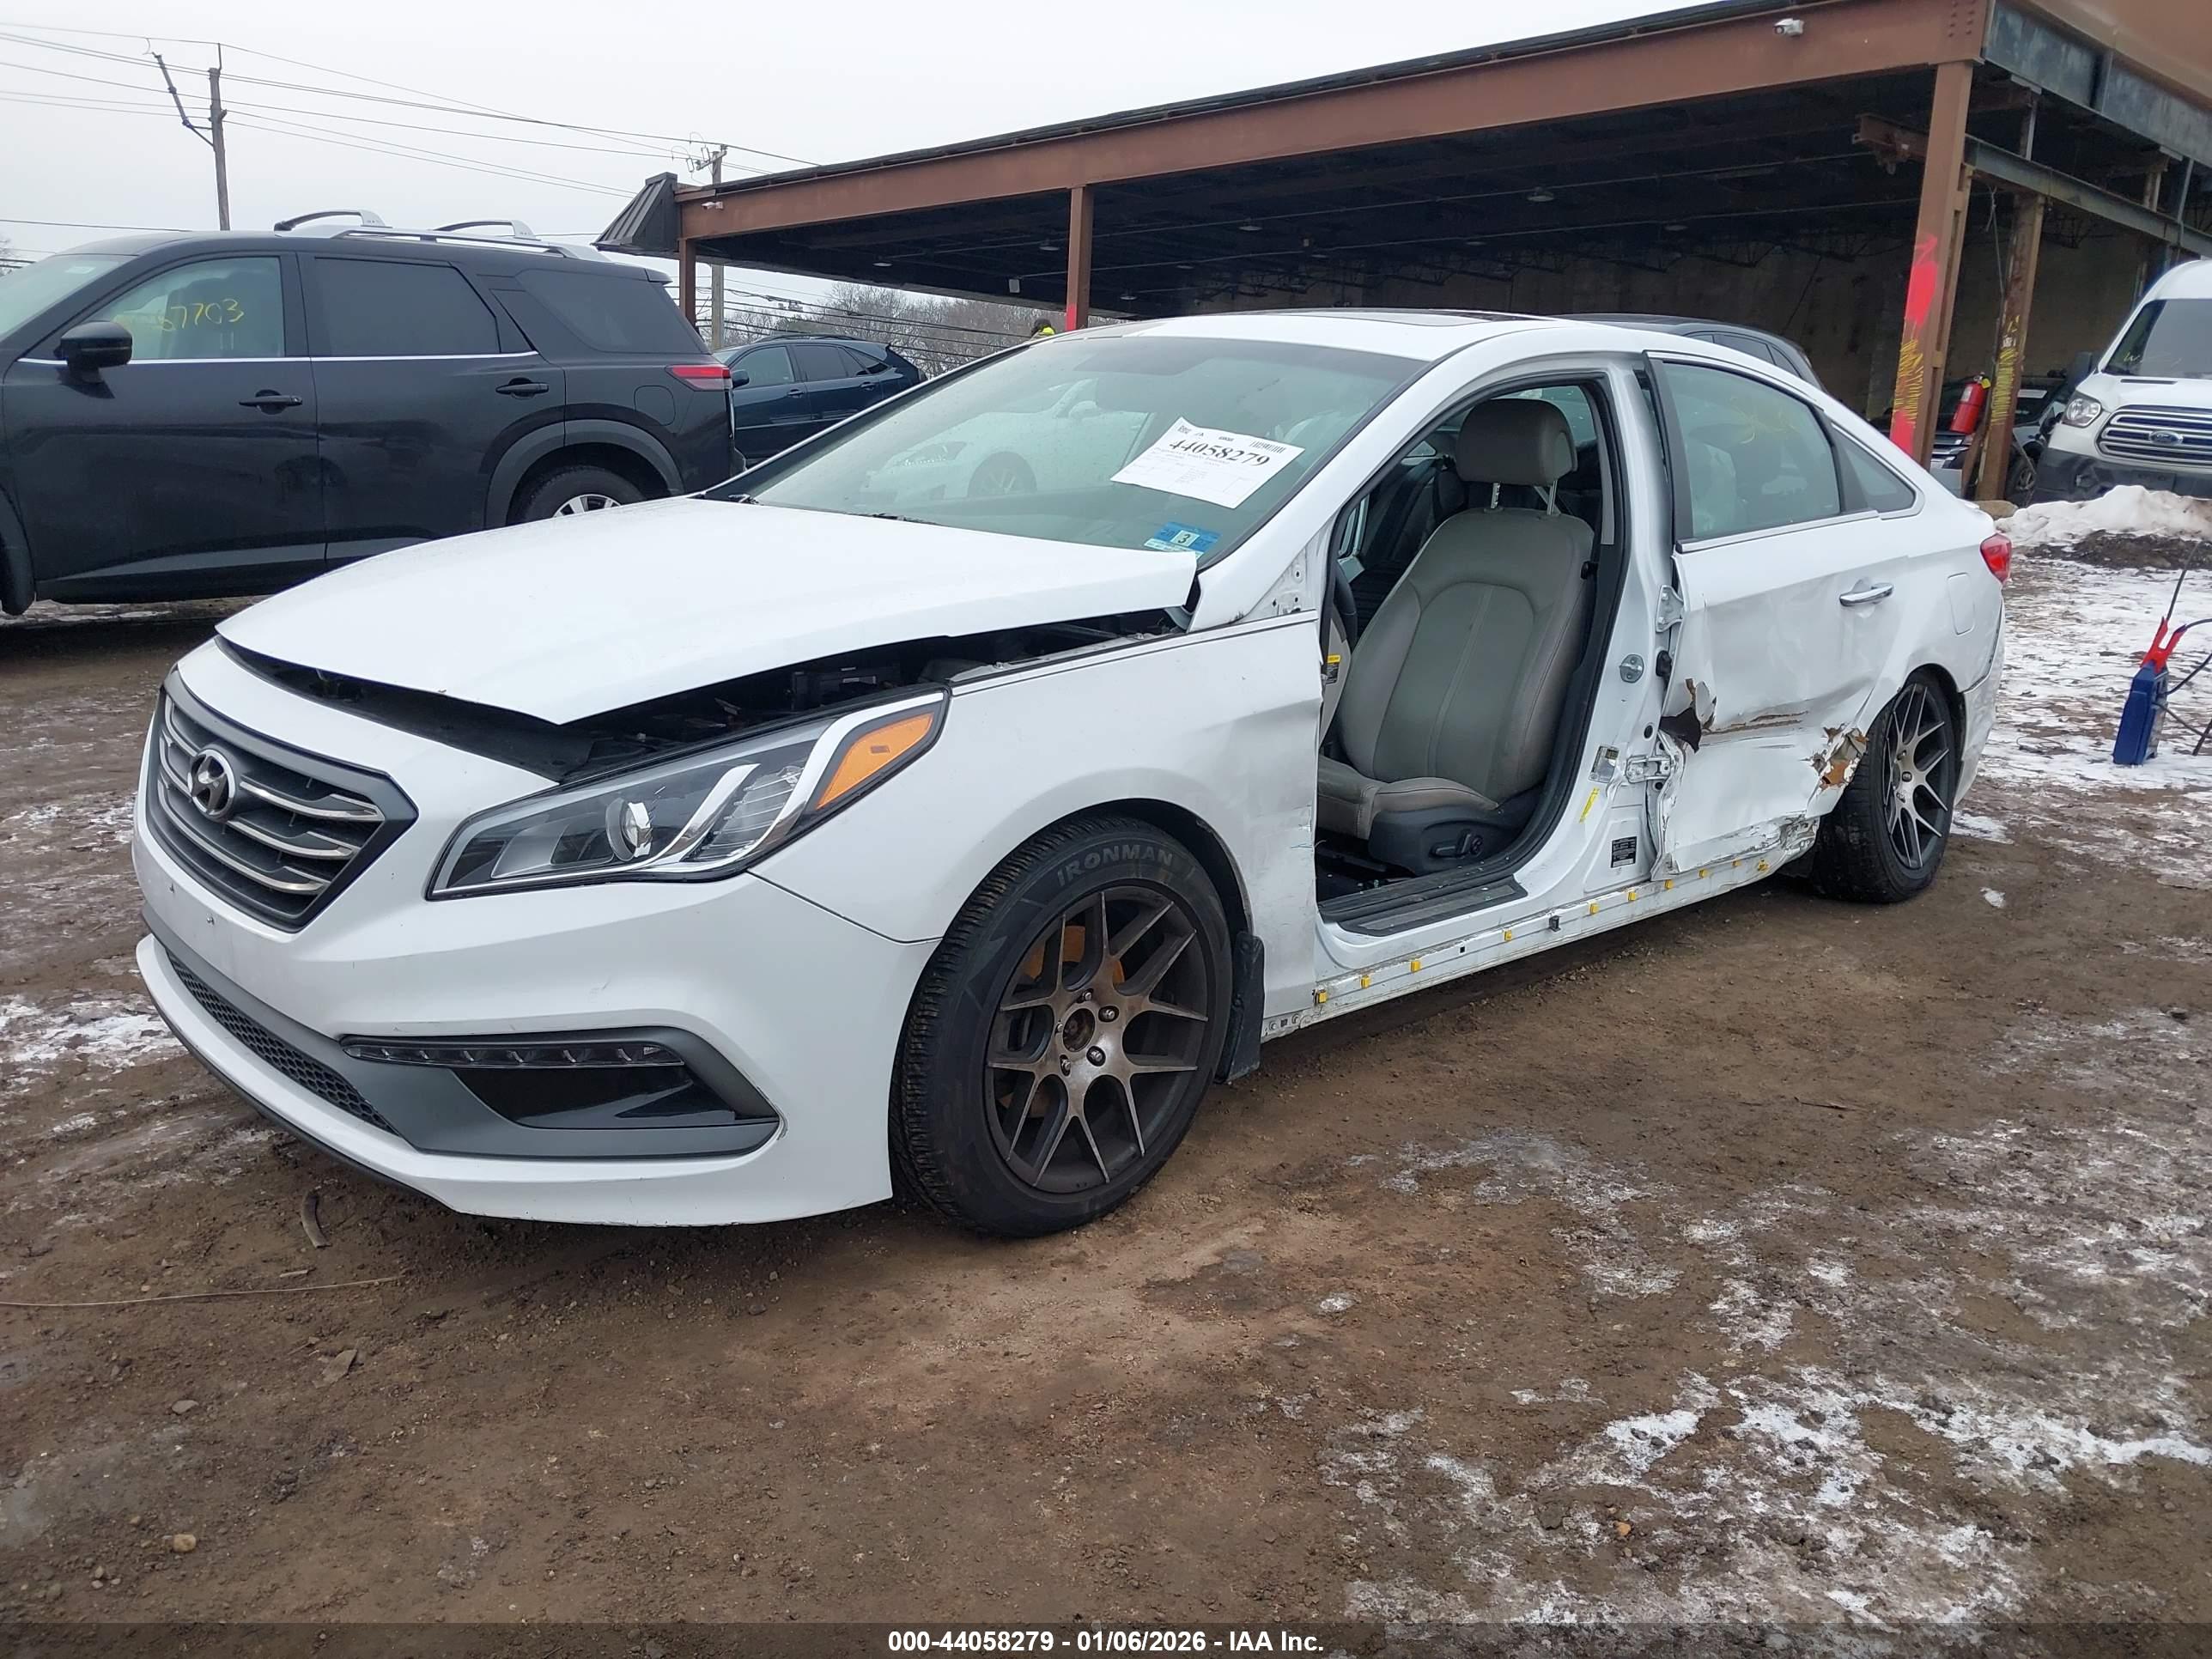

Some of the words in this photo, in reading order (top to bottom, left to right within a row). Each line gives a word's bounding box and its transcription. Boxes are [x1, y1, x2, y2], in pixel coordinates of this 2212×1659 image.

[1169, 439, 1271, 466] 44058279
[1176, 532, 1192, 544] 3
[1057, 844, 1173, 887] IRONMAN
